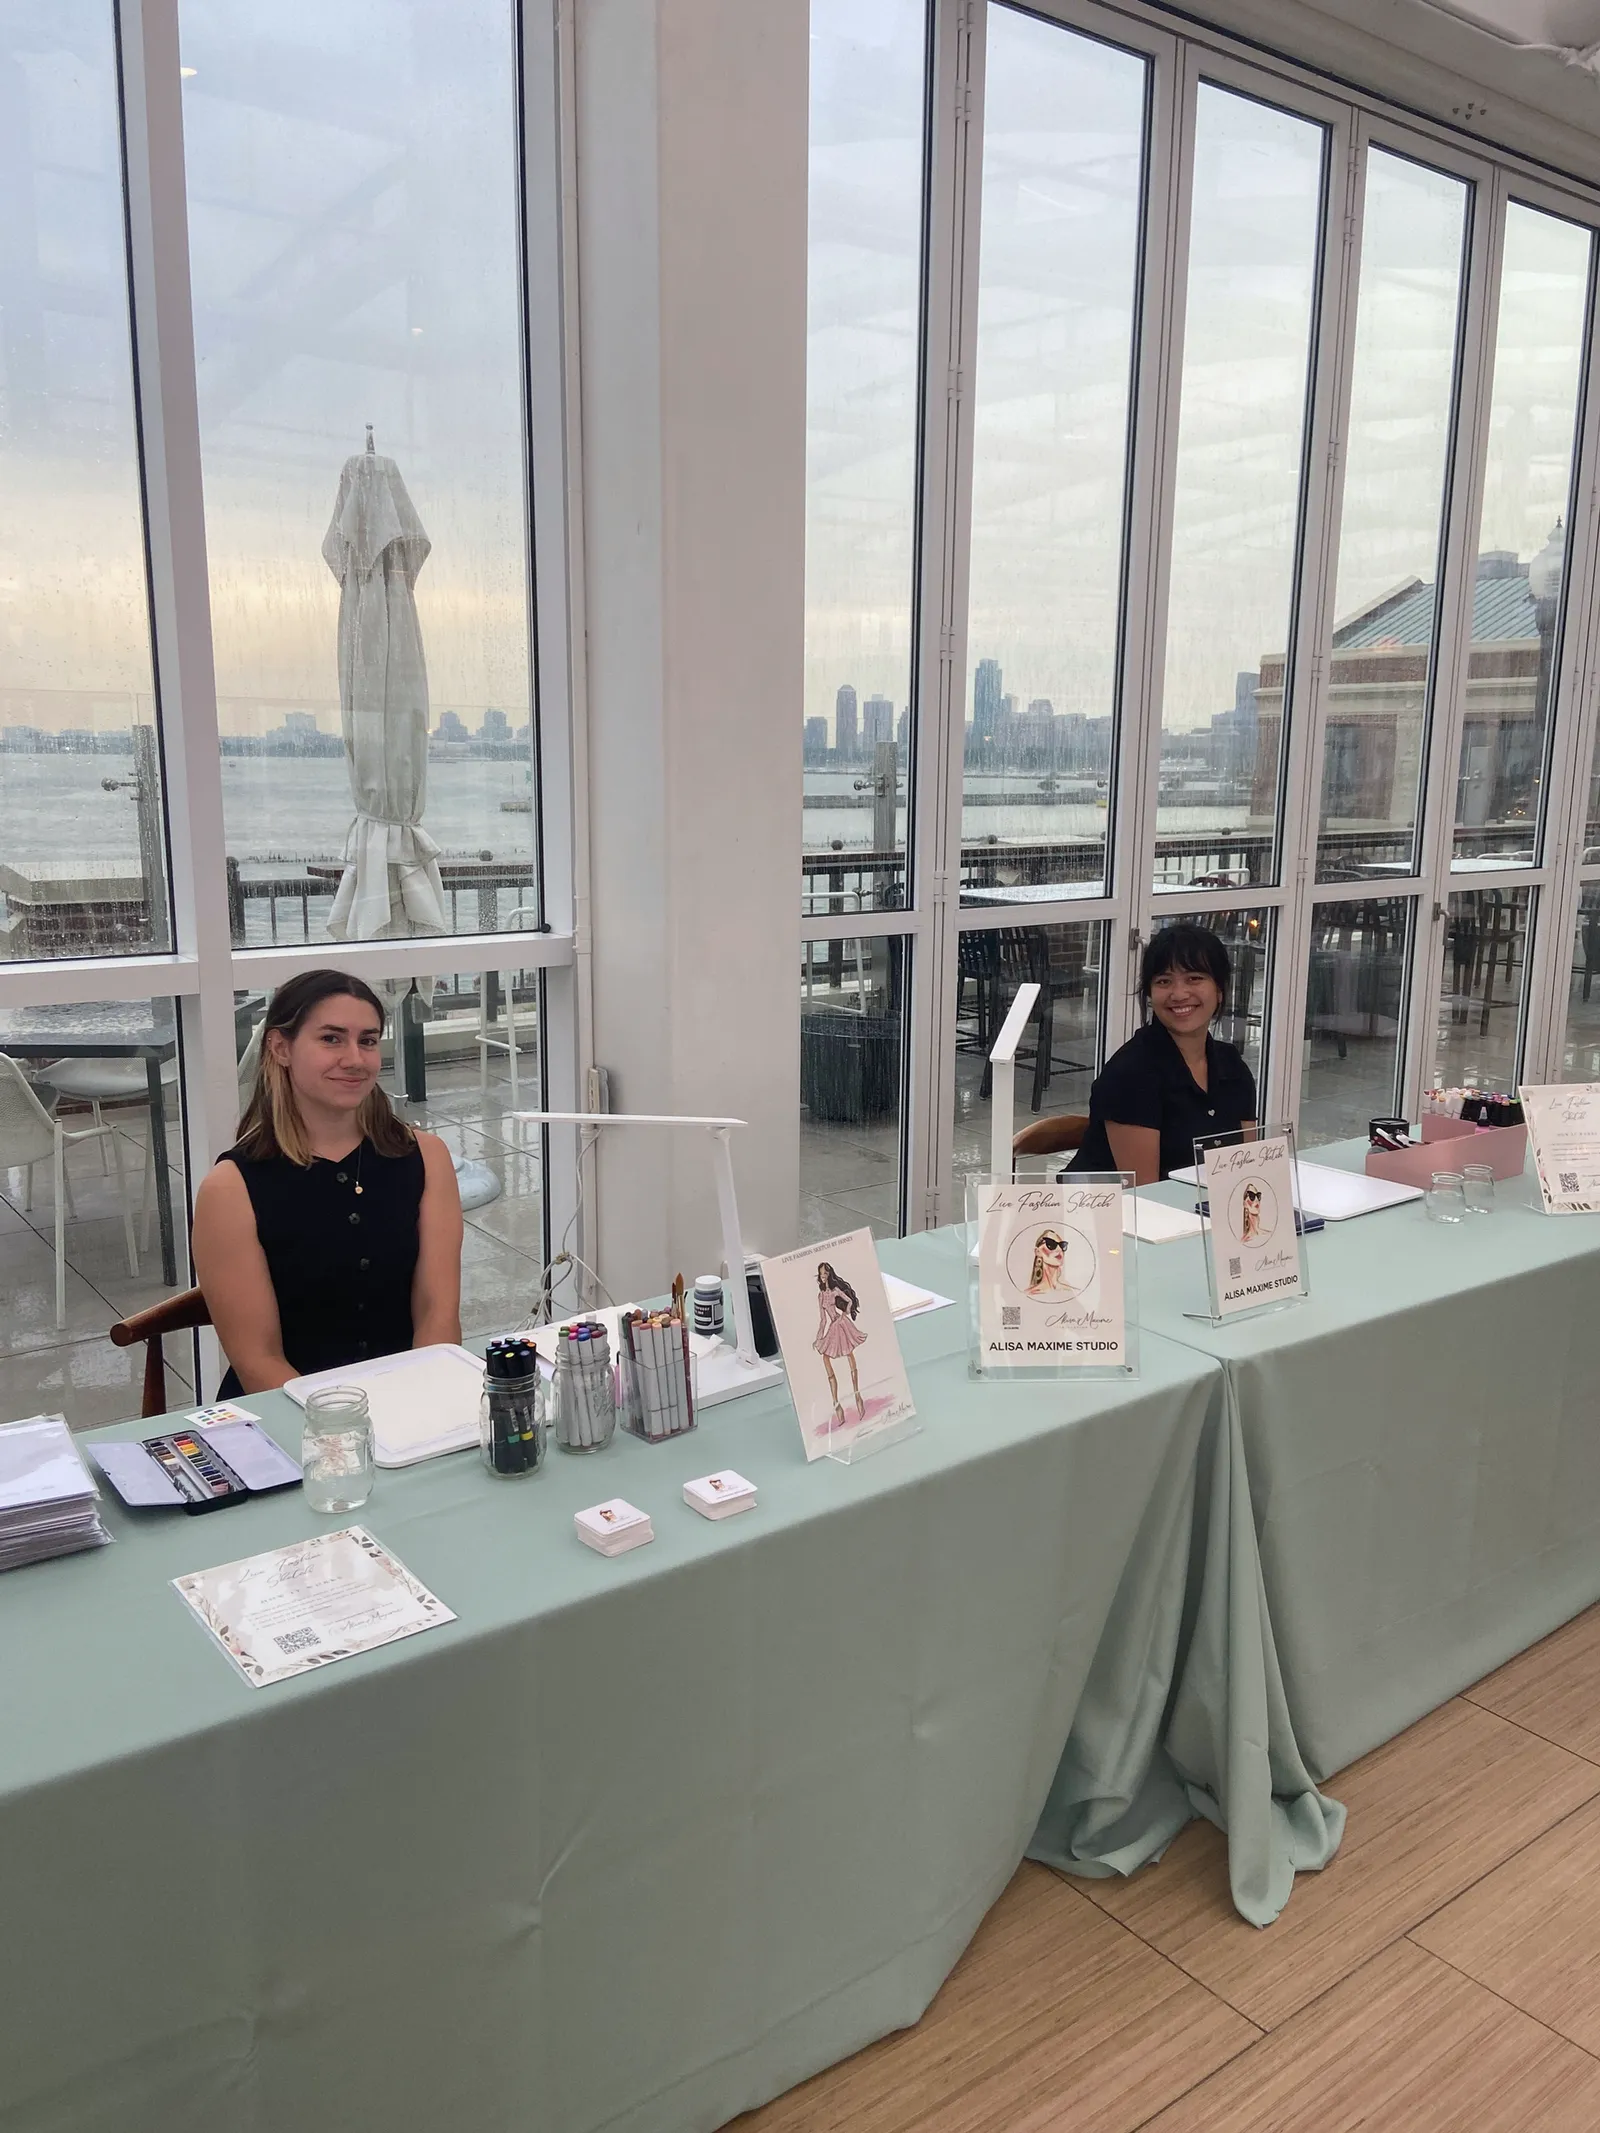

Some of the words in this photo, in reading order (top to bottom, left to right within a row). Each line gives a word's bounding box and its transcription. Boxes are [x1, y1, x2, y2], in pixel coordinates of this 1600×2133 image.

[986, 1192, 1013, 1213] Live
[1018, 1190, 1061, 1213] Fashion
[1066, 1190, 1116, 1214] Sketch
[1224, 1288, 1245, 1301] ALISA
[1246, 1281, 1273, 1295] MAXIME
[1274, 1275, 1298, 1288] STUDIO
[989, 1341, 1024, 1351] ALISA
[1027, 1341, 1073, 1351] MAXIME
[1076, 1341, 1119, 1351] STUDIO
